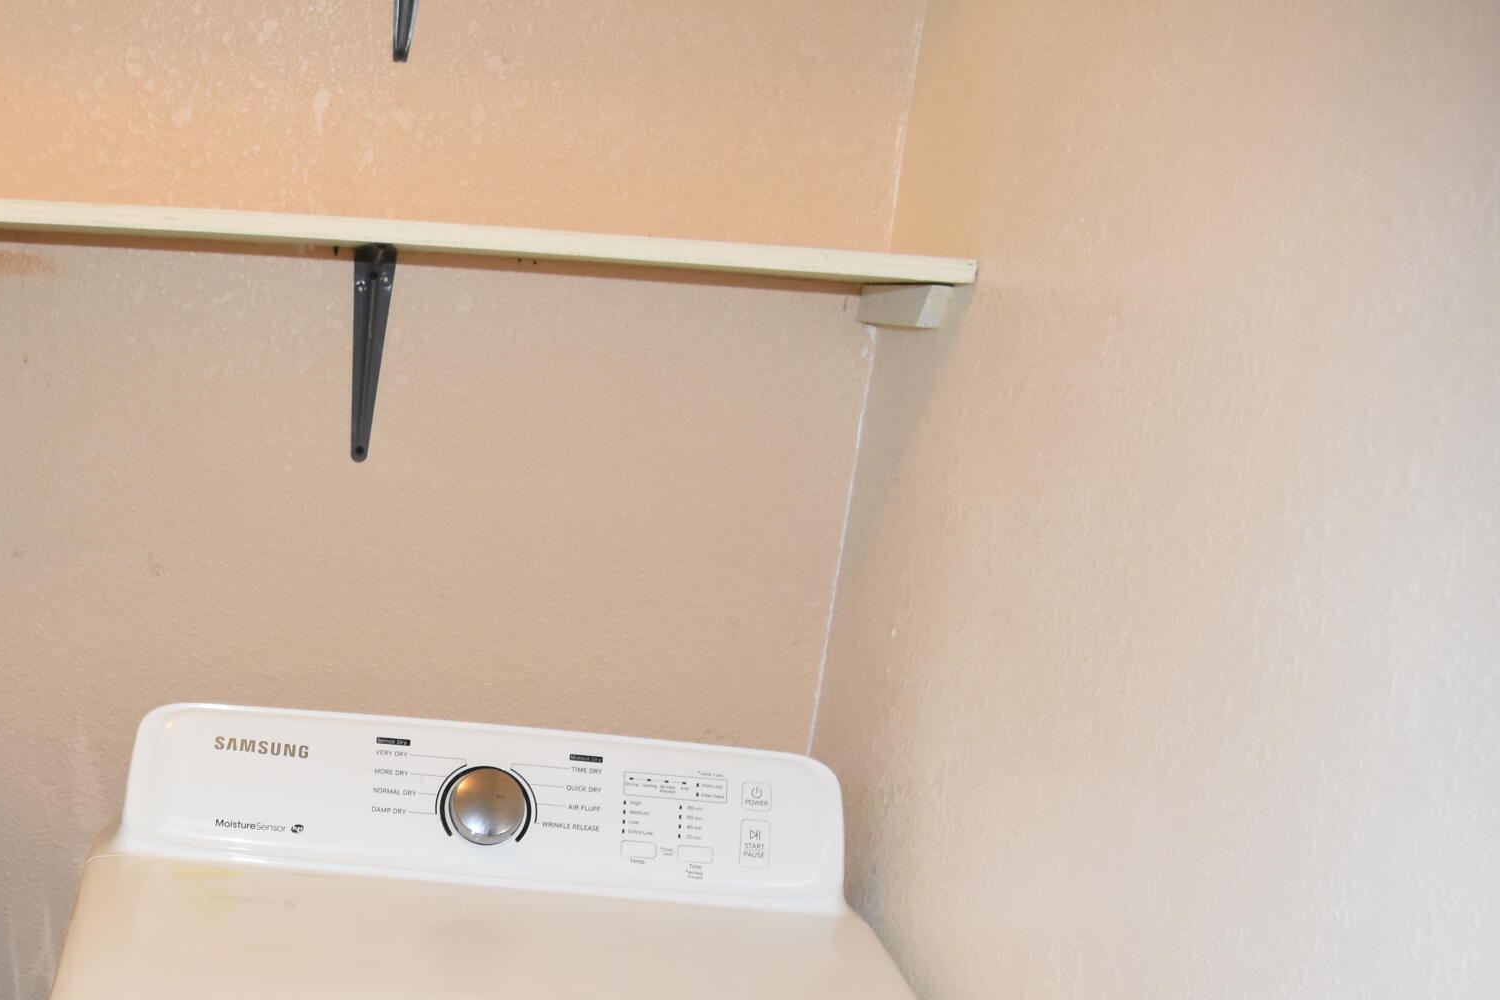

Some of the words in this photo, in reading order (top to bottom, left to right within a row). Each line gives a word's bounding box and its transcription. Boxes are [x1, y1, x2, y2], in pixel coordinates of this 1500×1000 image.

[214, 736, 309, 759] SAMSUNG
[375, 749, 393, 757] VERY
[394, 750, 408, 758] DRY
[374, 767, 394, 776] MORE
[572, 766, 587, 774] TIME
[372, 787, 400, 796] NORMAL
[402, 789, 417, 797] DRY
[566, 784, 586, 792] QUICK
[744, 799, 768, 807] POWER
[371, 806, 391, 814] DAMP
[392, 807, 406, 815] DRY
[541, 821, 571, 830] WRINKLE
[572, 823, 600, 832] RELEASE
[744, 842, 765, 850] START
[743, 850, 765, 859] PAUSE
